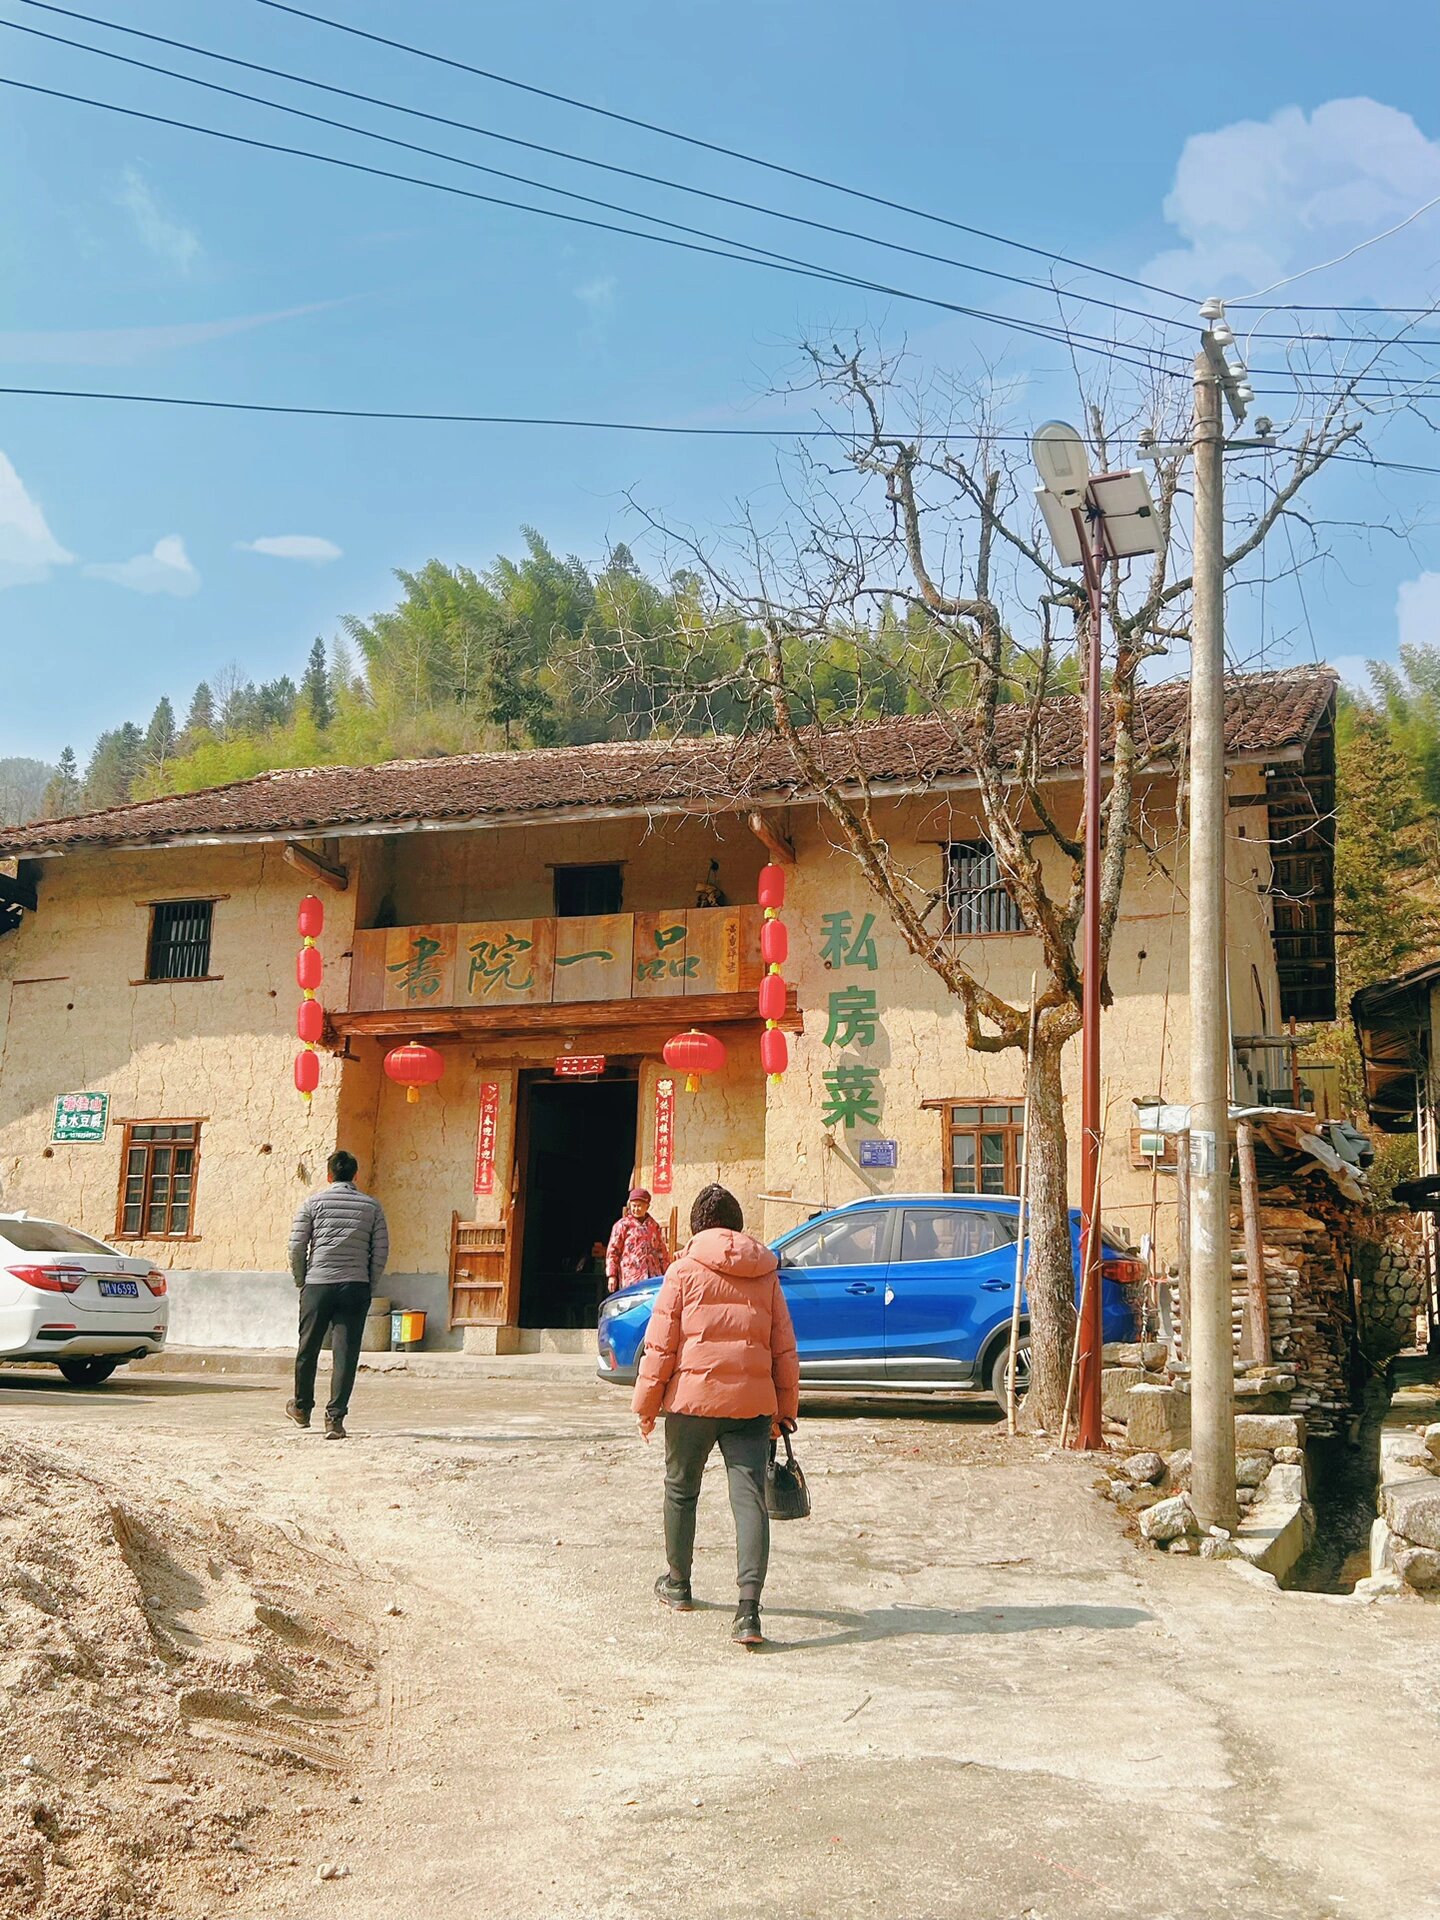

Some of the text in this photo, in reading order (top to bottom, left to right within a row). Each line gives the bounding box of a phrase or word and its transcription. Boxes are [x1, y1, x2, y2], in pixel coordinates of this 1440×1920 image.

[819, 910, 879, 1128] 私房菜
[57, 1113, 103, 1128] 泉水豆腐
